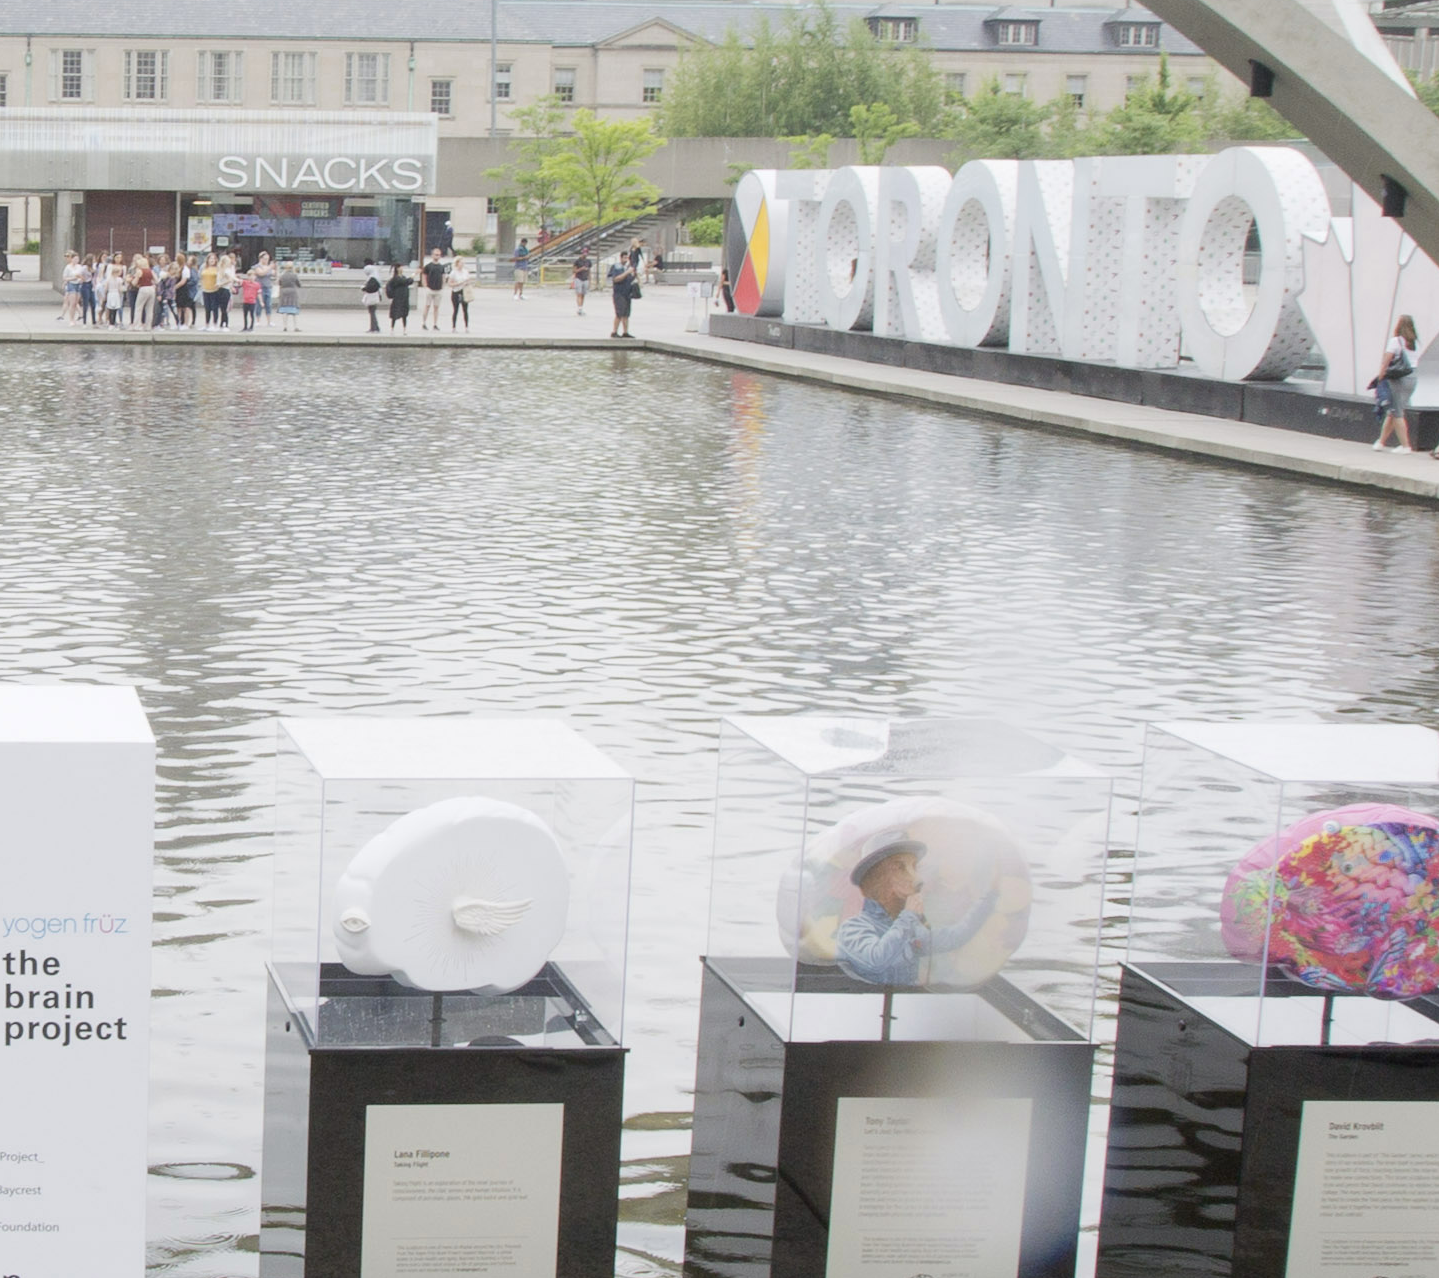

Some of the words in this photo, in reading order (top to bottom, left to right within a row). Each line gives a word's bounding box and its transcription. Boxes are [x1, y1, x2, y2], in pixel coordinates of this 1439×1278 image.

[217, 156, 423, 190] SNACKS
[775, 146, 1330, 382] TORONTO
[3, 917, 77, 939] yogen
[83, 913, 129, 934] früz
[2, 950, 60, 976] the
[5, 983, 94, 1009] brain
[5, 1014, 127, 1046] project
